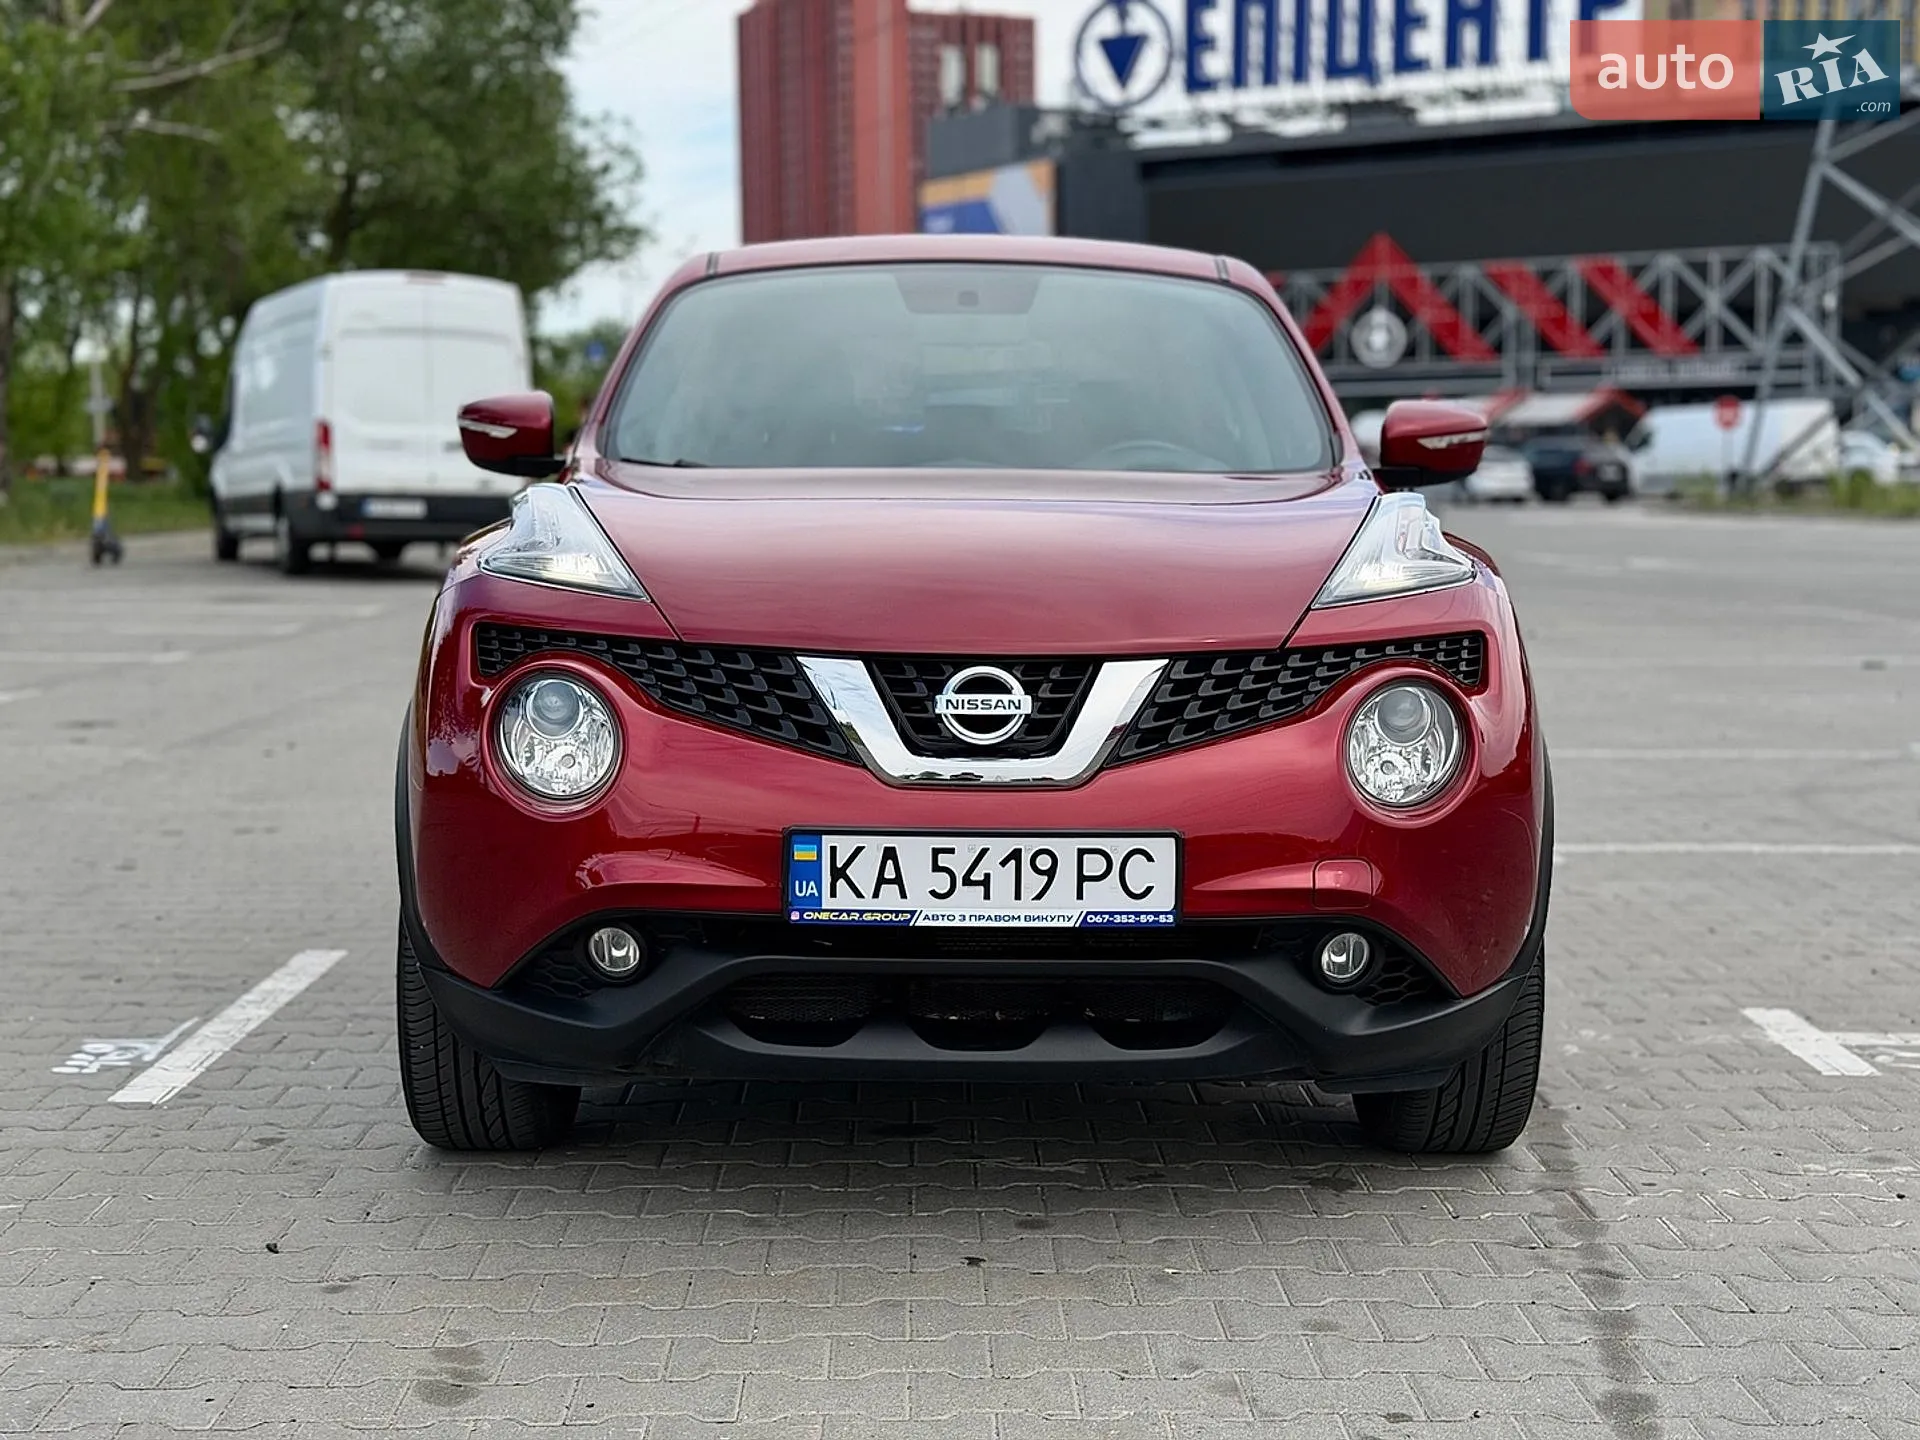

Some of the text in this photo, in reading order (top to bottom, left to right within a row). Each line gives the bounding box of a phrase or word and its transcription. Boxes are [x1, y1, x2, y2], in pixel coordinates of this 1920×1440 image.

[945, 699, 1022, 711] NISSAN
[829, 845, 1156, 901] KA 5419 PC
[795, 880, 819, 897] UA
[803, 911, 911, 922] ONECAR.GROUP
[922, 913, 956, 923] АВТО
[969, 914, 1020, 923] ПРАВОМ
[1024, 914, 1074, 923] ВИКУПУ
[1086, 914, 1174, 924] 067-352-59-53
